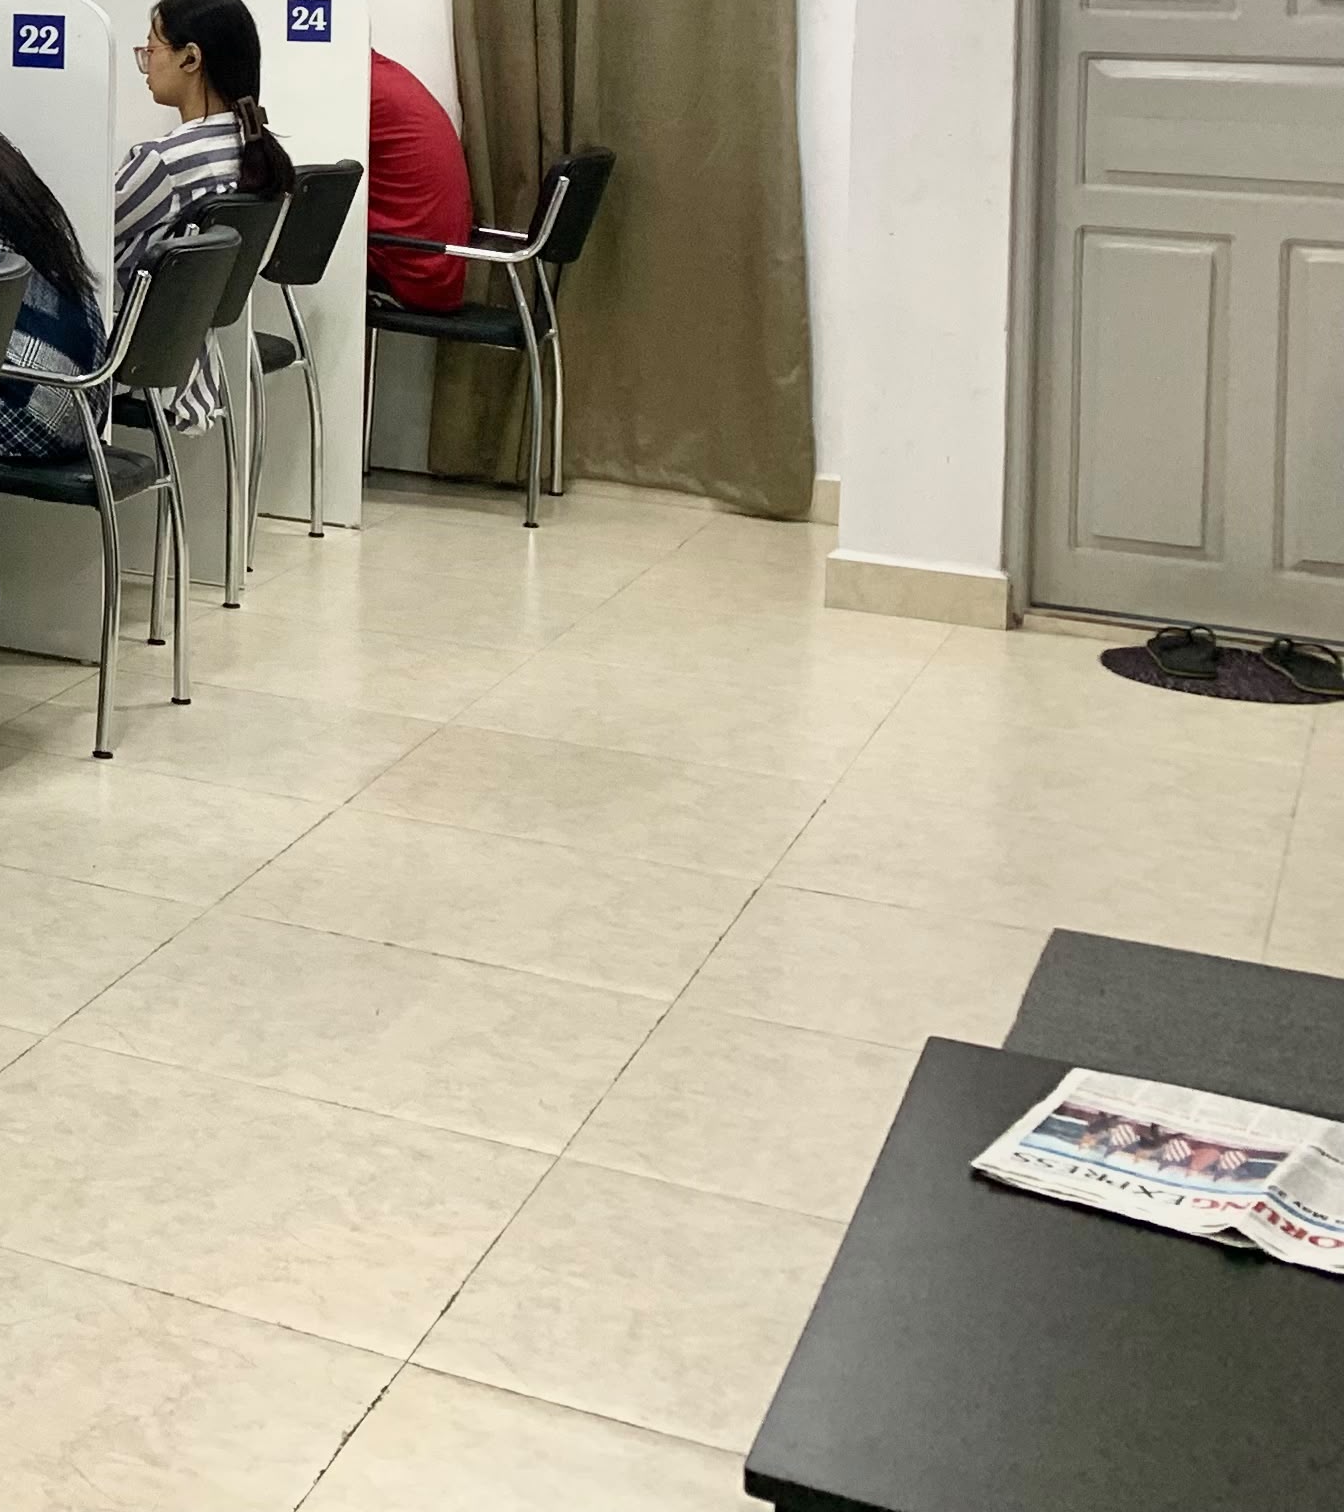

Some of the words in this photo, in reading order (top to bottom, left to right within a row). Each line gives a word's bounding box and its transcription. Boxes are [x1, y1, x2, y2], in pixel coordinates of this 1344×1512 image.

[291, 6, 327, 31] 24
[18, 24, 60, 55] 22
[1012, 1151, 1186, 1206] EXPRESS
